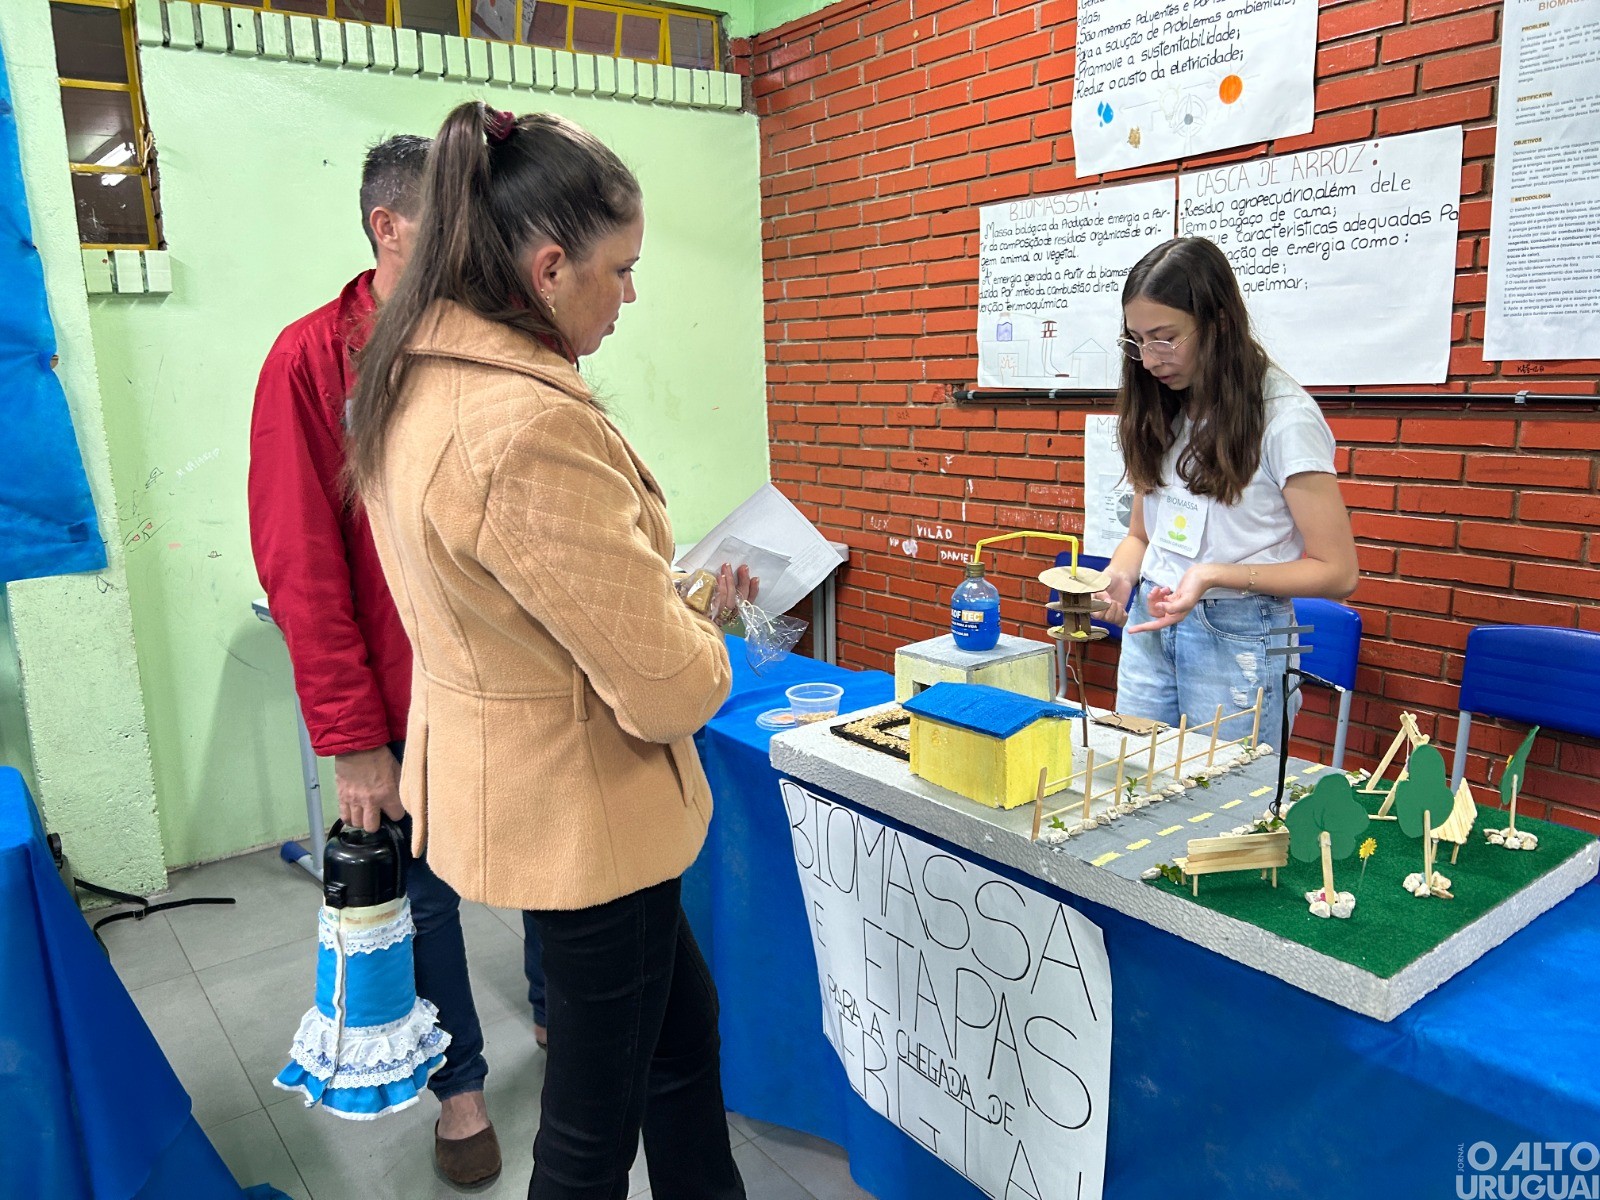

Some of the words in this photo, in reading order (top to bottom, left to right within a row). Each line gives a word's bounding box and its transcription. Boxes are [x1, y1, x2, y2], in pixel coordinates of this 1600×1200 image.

[1182, 2, 1190, 12] e
[1521, 22, 1550, 31] PROBLEMA
[1095, 46, 1102, 56] a
[1146, 22, 1159, 41] de
[1127, 55, 1135, 66] a
[1108, 79, 1116, 90] o
[1117, 70, 1147, 88] custo
[1150, 60, 1166, 81] da
[1516, 91, 1553, 103] JUSTIFICATIVA
[1513, 137, 1542, 146] OBJETIVOS
[1196, 163, 1250, 198] CASCA
[1257, 158, 1281, 187] DE
[1514, 193, 1551, 203] METODOLOGIA
[1049, 217, 1059, 230] da
[1094, 212, 1104, 226] de
[1143, 212, 1149, 220] a
[1209, 219, 1217, 230] o
[1220, 211, 1264, 233] bagaço
[1270, 203, 1286, 222] de
[1343, 206, 1432, 234] adequadas
[989, 239, 998, 251] da
[1044, 232, 1052, 246] de
[1131, 224, 1141, 237] de
[1000, 251, 1030, 264] animal
[1033, 252, 1043, 261] ou
[1262, 240, 1279, 257] de
[1286, 238, 1345, 260] energia
[1024, 267, 1052, 287] gerada
[1054, 271, 1061, 280] a
[1086, 264, 1097, 279] da
[1036, 283, 1045, 295] da
[1093, 278, 1119, 293] direta
[1167, 496, 1198, 511] BIOMASSA
[782, 781, 1097, 1022] BIOMASSA
[813, 900, 827, 947] E
[863, 917, 1092, 1130] ETAPAS
[827, 973, 864, 1030] PARA
[870, 1011, 885, 1046] A
[896, 1029, 976, 1111] CHEGADA
[987, 1094, 1016, 1137] DE
